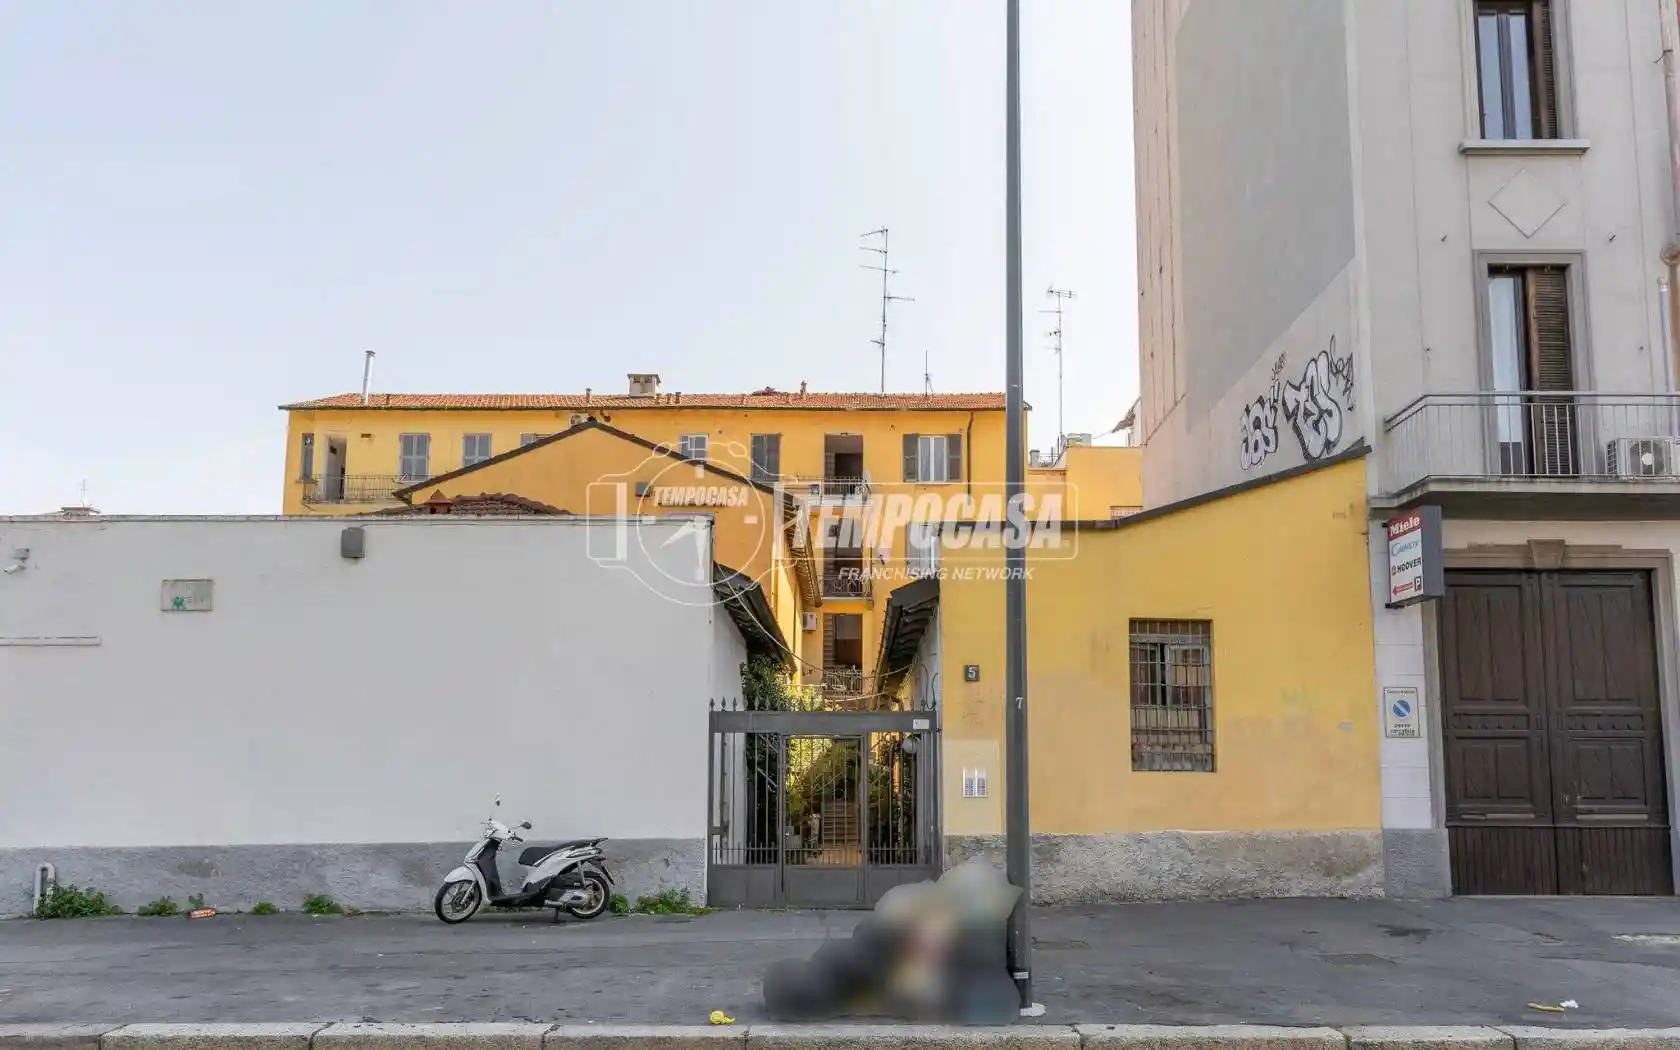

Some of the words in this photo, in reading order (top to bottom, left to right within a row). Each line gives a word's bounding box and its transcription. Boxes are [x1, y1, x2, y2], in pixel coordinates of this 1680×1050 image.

[1390, 516, 1420, 537] Miele
[1397, 556, 1422, 573] HOOVER
[967, 666, 977, 679] 5
[1015, 697, 1024, 710] 7
